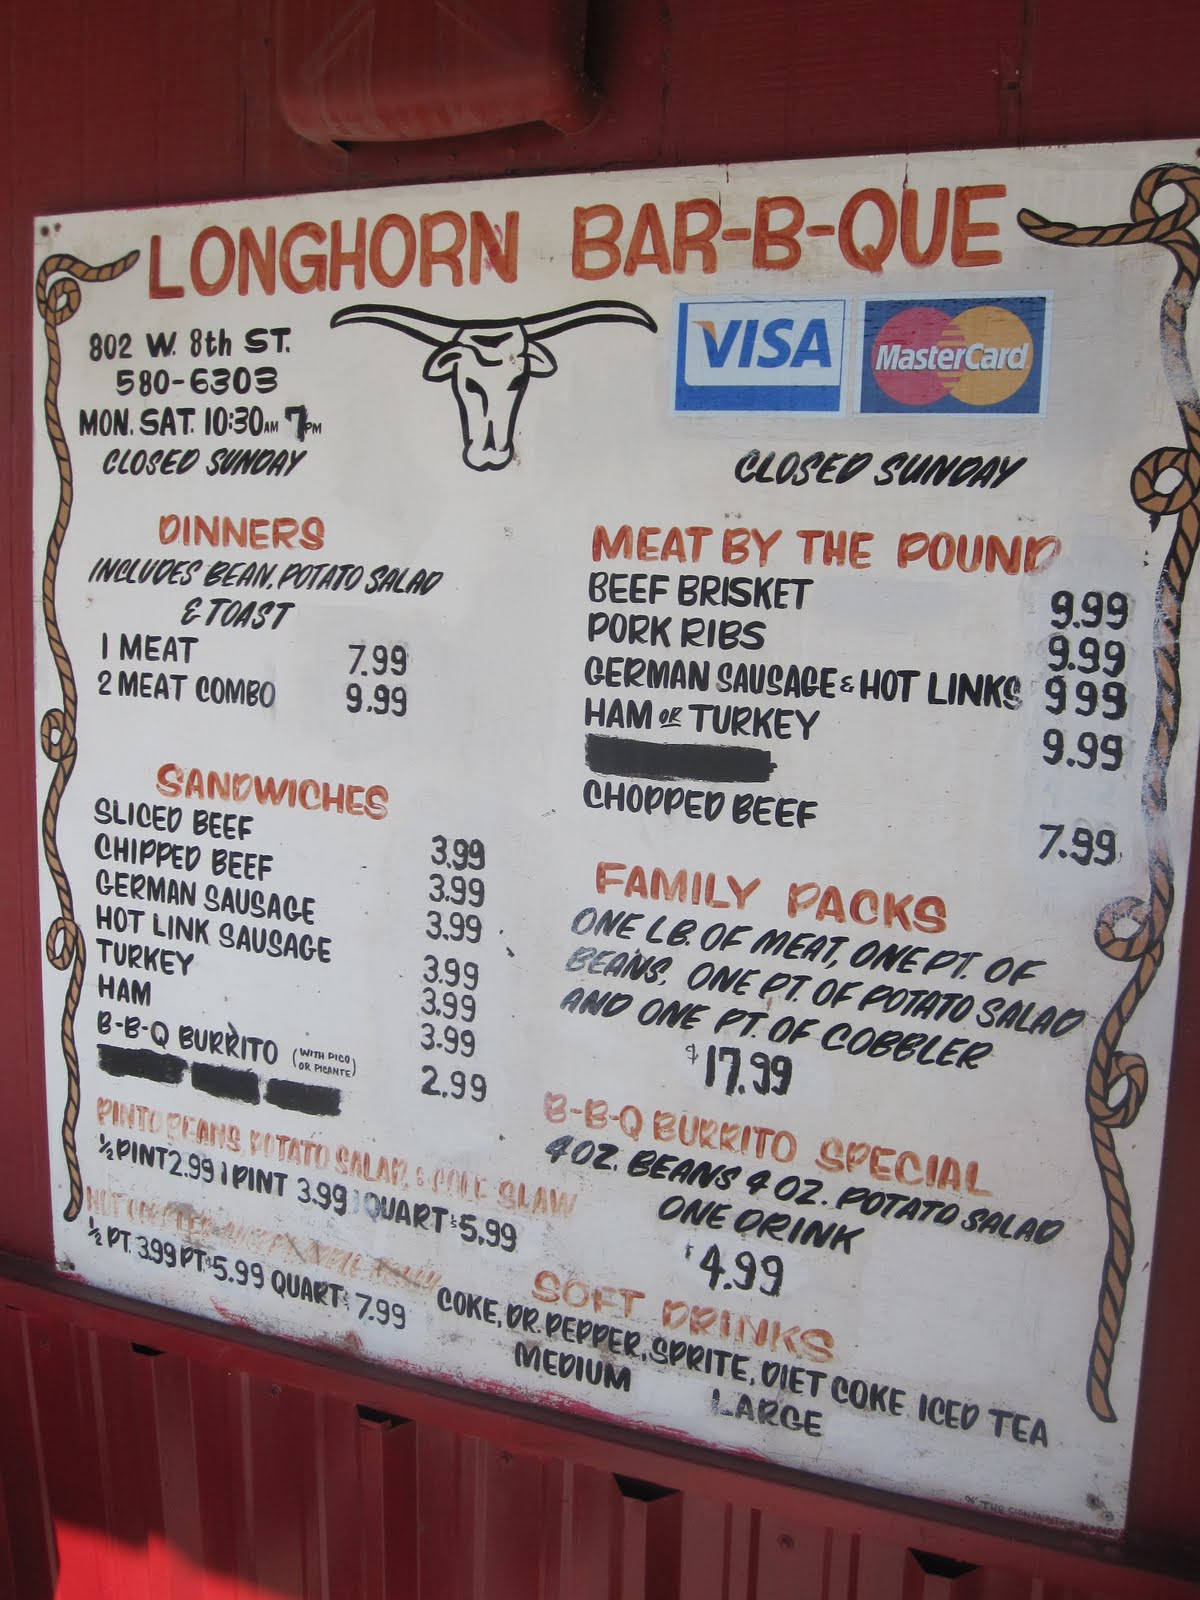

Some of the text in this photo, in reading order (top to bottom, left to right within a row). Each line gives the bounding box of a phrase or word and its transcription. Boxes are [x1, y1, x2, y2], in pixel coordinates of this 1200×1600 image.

[149, 184, 1006, 299] LONGHORN BAR-B-QUE
[89, 327, 291, 361] 802 W. 8th ST.
[692, 319, 832, 369] VISA
[874, 343, 1028, 372] MasterCard
[116, 366, 278, 397] 580-6303
[79, 408, 134, 436] MON.
[139, 407, 196, 436] SAT.
[102, 448, 307, 477] CLOSED SUNDAY
[735, 449, 1028, 488] CLOSED SUNDAY
[158, 514, 325, 551] DINNERS
[592, 524, 1062, 575] MEAT BY THE POUND
[88, 557, 203, 587] INCLUDES
[277, 562, 364, 591] POTATO
[364, 565, 444, 596] SALAD
[588, 571, 814, 611] BEEF BRISKET
[205, 598, 295, 630] TOAST
[587, 612, 766, 650] PORK RIBS
[1051, 590, 1128, 630] 9.99
[119, 633, 199, 664] MEAT
[348, 644, 408, 676] 7.99
[1048, 635, 1125, 677] 9.99
[97, 670, 276, 708] 2 MEAT COMBO
[346, 682, 407, 717] 9.99
[584, 655, 709, 692] GERMAN
[716, 661, 836, 699] SAUSAGE
[859, 669, 921, 703] HOT
[928, 673, 1023, 711] LINKS
[584, 698, 652, 730] HAM
[688, 703, 821, 740] TURKEY
[1043, 728, 1123, 771] 9.99
[156, 763, 389, 820] SANDWICHES
[583, 779, 818, 828] CHOPPED BEEF
[94, 797, 254, 840] SLICED BEEF
[94, 832, 274, 882] CHIPPED BEEF
[431, 835, 486, 870] 3.99
[1038, 824, 1117, 866] 7.99
[96, 869, 315, 926] GERMAN SAUSAGE
[428, 873, 486, 908] 3.99
[596, 862, 947, 933] FAMILY PACKS
[97, 905, 332, 963] HOT LINK SAUSAGE
[426, 910, 482, 944] 3.99
[571, 907, 1047, 987] ONE LB. OF MEAT, ONE PT. OF
[96, 938, 194, 976] TURKEY
[422, 954, 479, 991] 3.99
[98, 974, 151, 1007] HAM
[421, 986, 476, 1023] 3.99
[686, 961, 760, 995] ONE
[758, 971, 812, 1003] PT.
[811, 978, 863, 1012] OF
[858, 984, 976, 1023] POTATO
[975, 997, 1086, 1038] SALAD
[98, 1010, 279, 1066] B-B-Q BURRITO
[421, 1022, 476, 1057] 3.99
[559, 987, 993, 1070] AND ONE PT. OF COBBLER
[298, 1062, 311, 1072] OR
[421, 1065, 487, 1103] 2.99
[97, 1097, 161, 1134] PINTO
[497, 1179, 577, 1217] SLAW
[543, 1090, 993, 1197] B-B-Q BURRITO SPECIAL
[116, 1138, 169, 1170] PINT
[169, 1150, 214, 1183] 2.99
[233, 1164, 288, 1197] PINT
[297, 1177, 347, 1216] 3.99
[364, 1191, 449, 1233] QUART
[626, 1150, 742, 1191] BEANS
[834, 1185, 960, 1226] POTATO
[960, 1206, 1066, 1245] SALAD
[658, 1195, 865, 1255] ONE DRINK
[107, 1226, 131, 1253] PT.
[271, 1269, 344, 1309] QUART
[531, 1270, 836, 1364] SOFT DRINKS
[506, 1303, 541, 1335] DR.
[762, 1360, 827, 1396] DIET
[830, 1375, 905, 1417] COKE
[918, 1395, 979, 1430] ICED
[988, 1407, 1048, 1448] TEA
[513, 1342, 632, 1392] MEDIUM
[711, 1389, 823, 1438] LARGE
